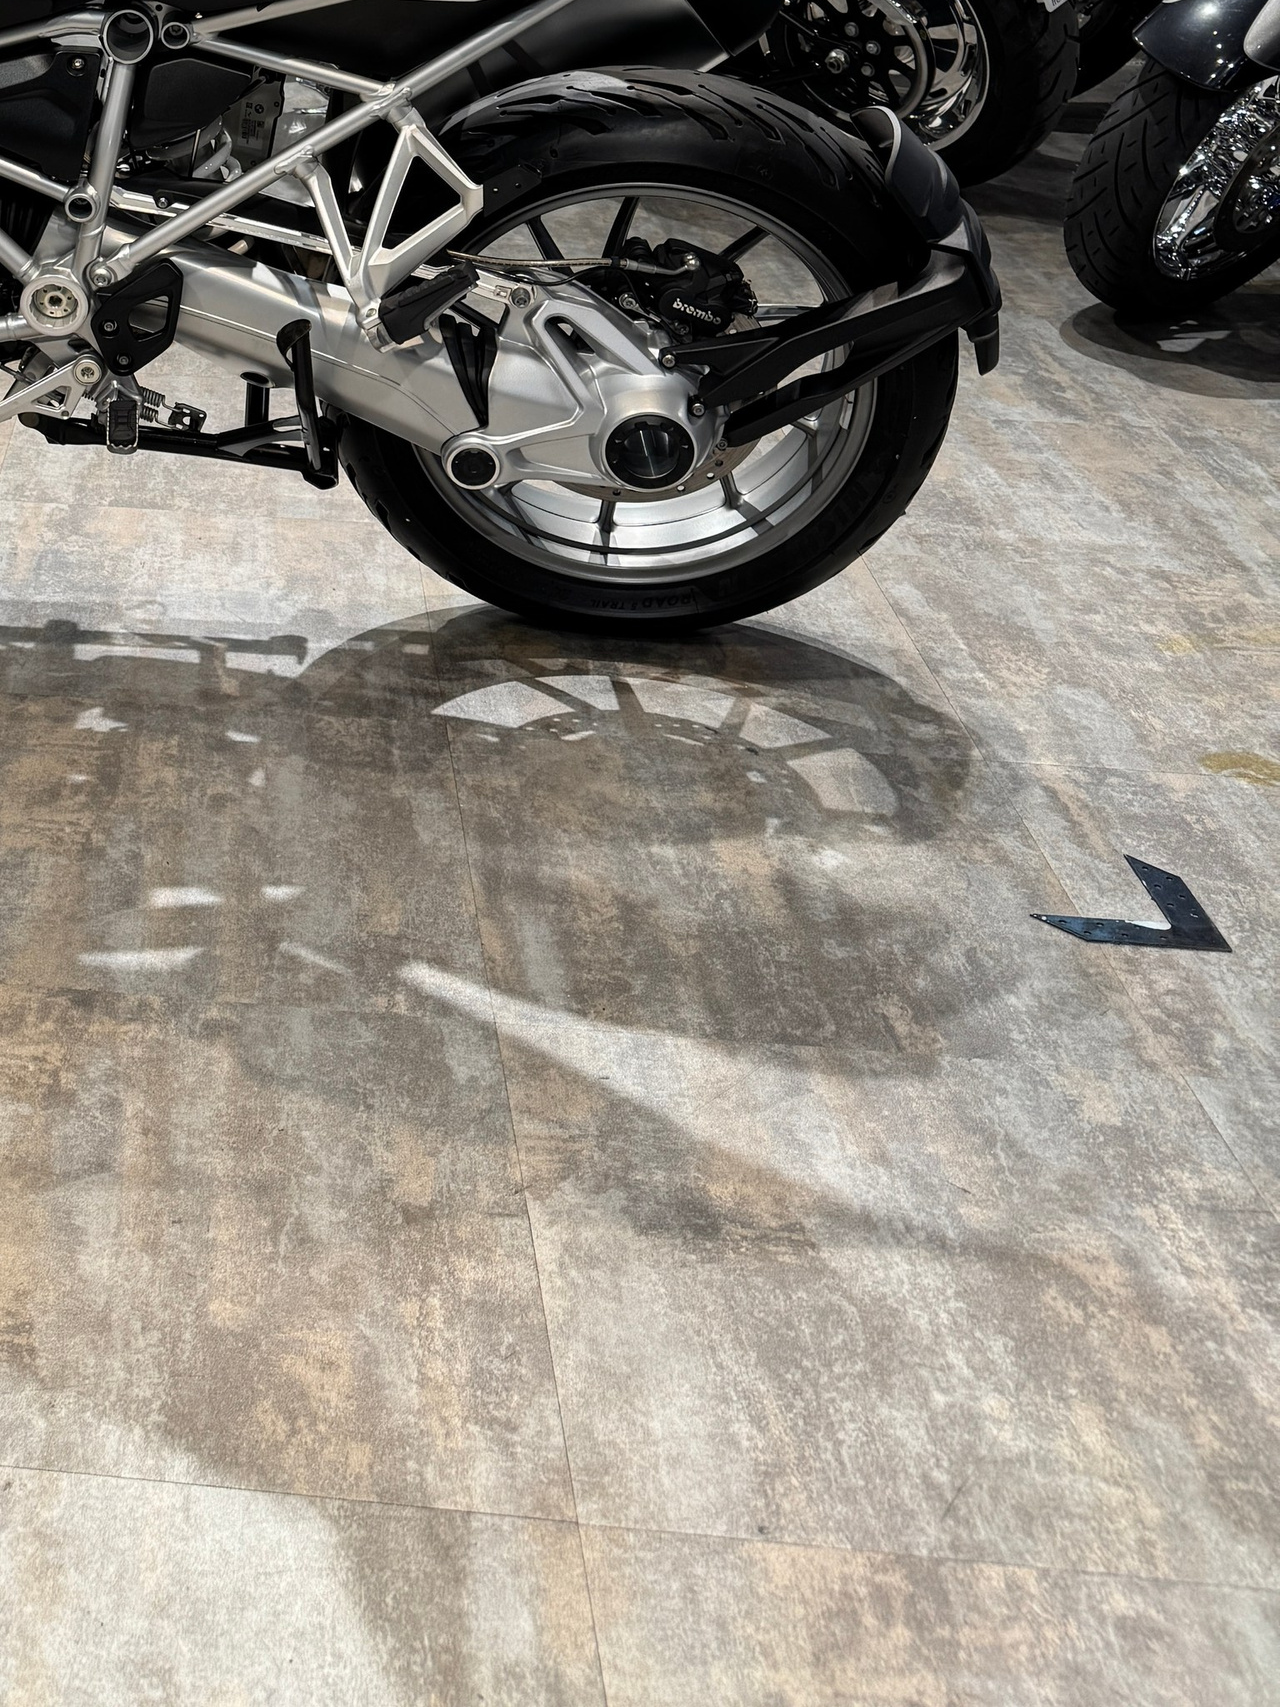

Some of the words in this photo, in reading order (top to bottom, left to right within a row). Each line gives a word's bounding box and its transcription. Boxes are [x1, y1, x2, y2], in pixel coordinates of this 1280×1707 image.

[672, 297, 722, 326] brembo
[589, 598, 626, 611] TRAIL
[643, 592, 691, 610] ROAD
